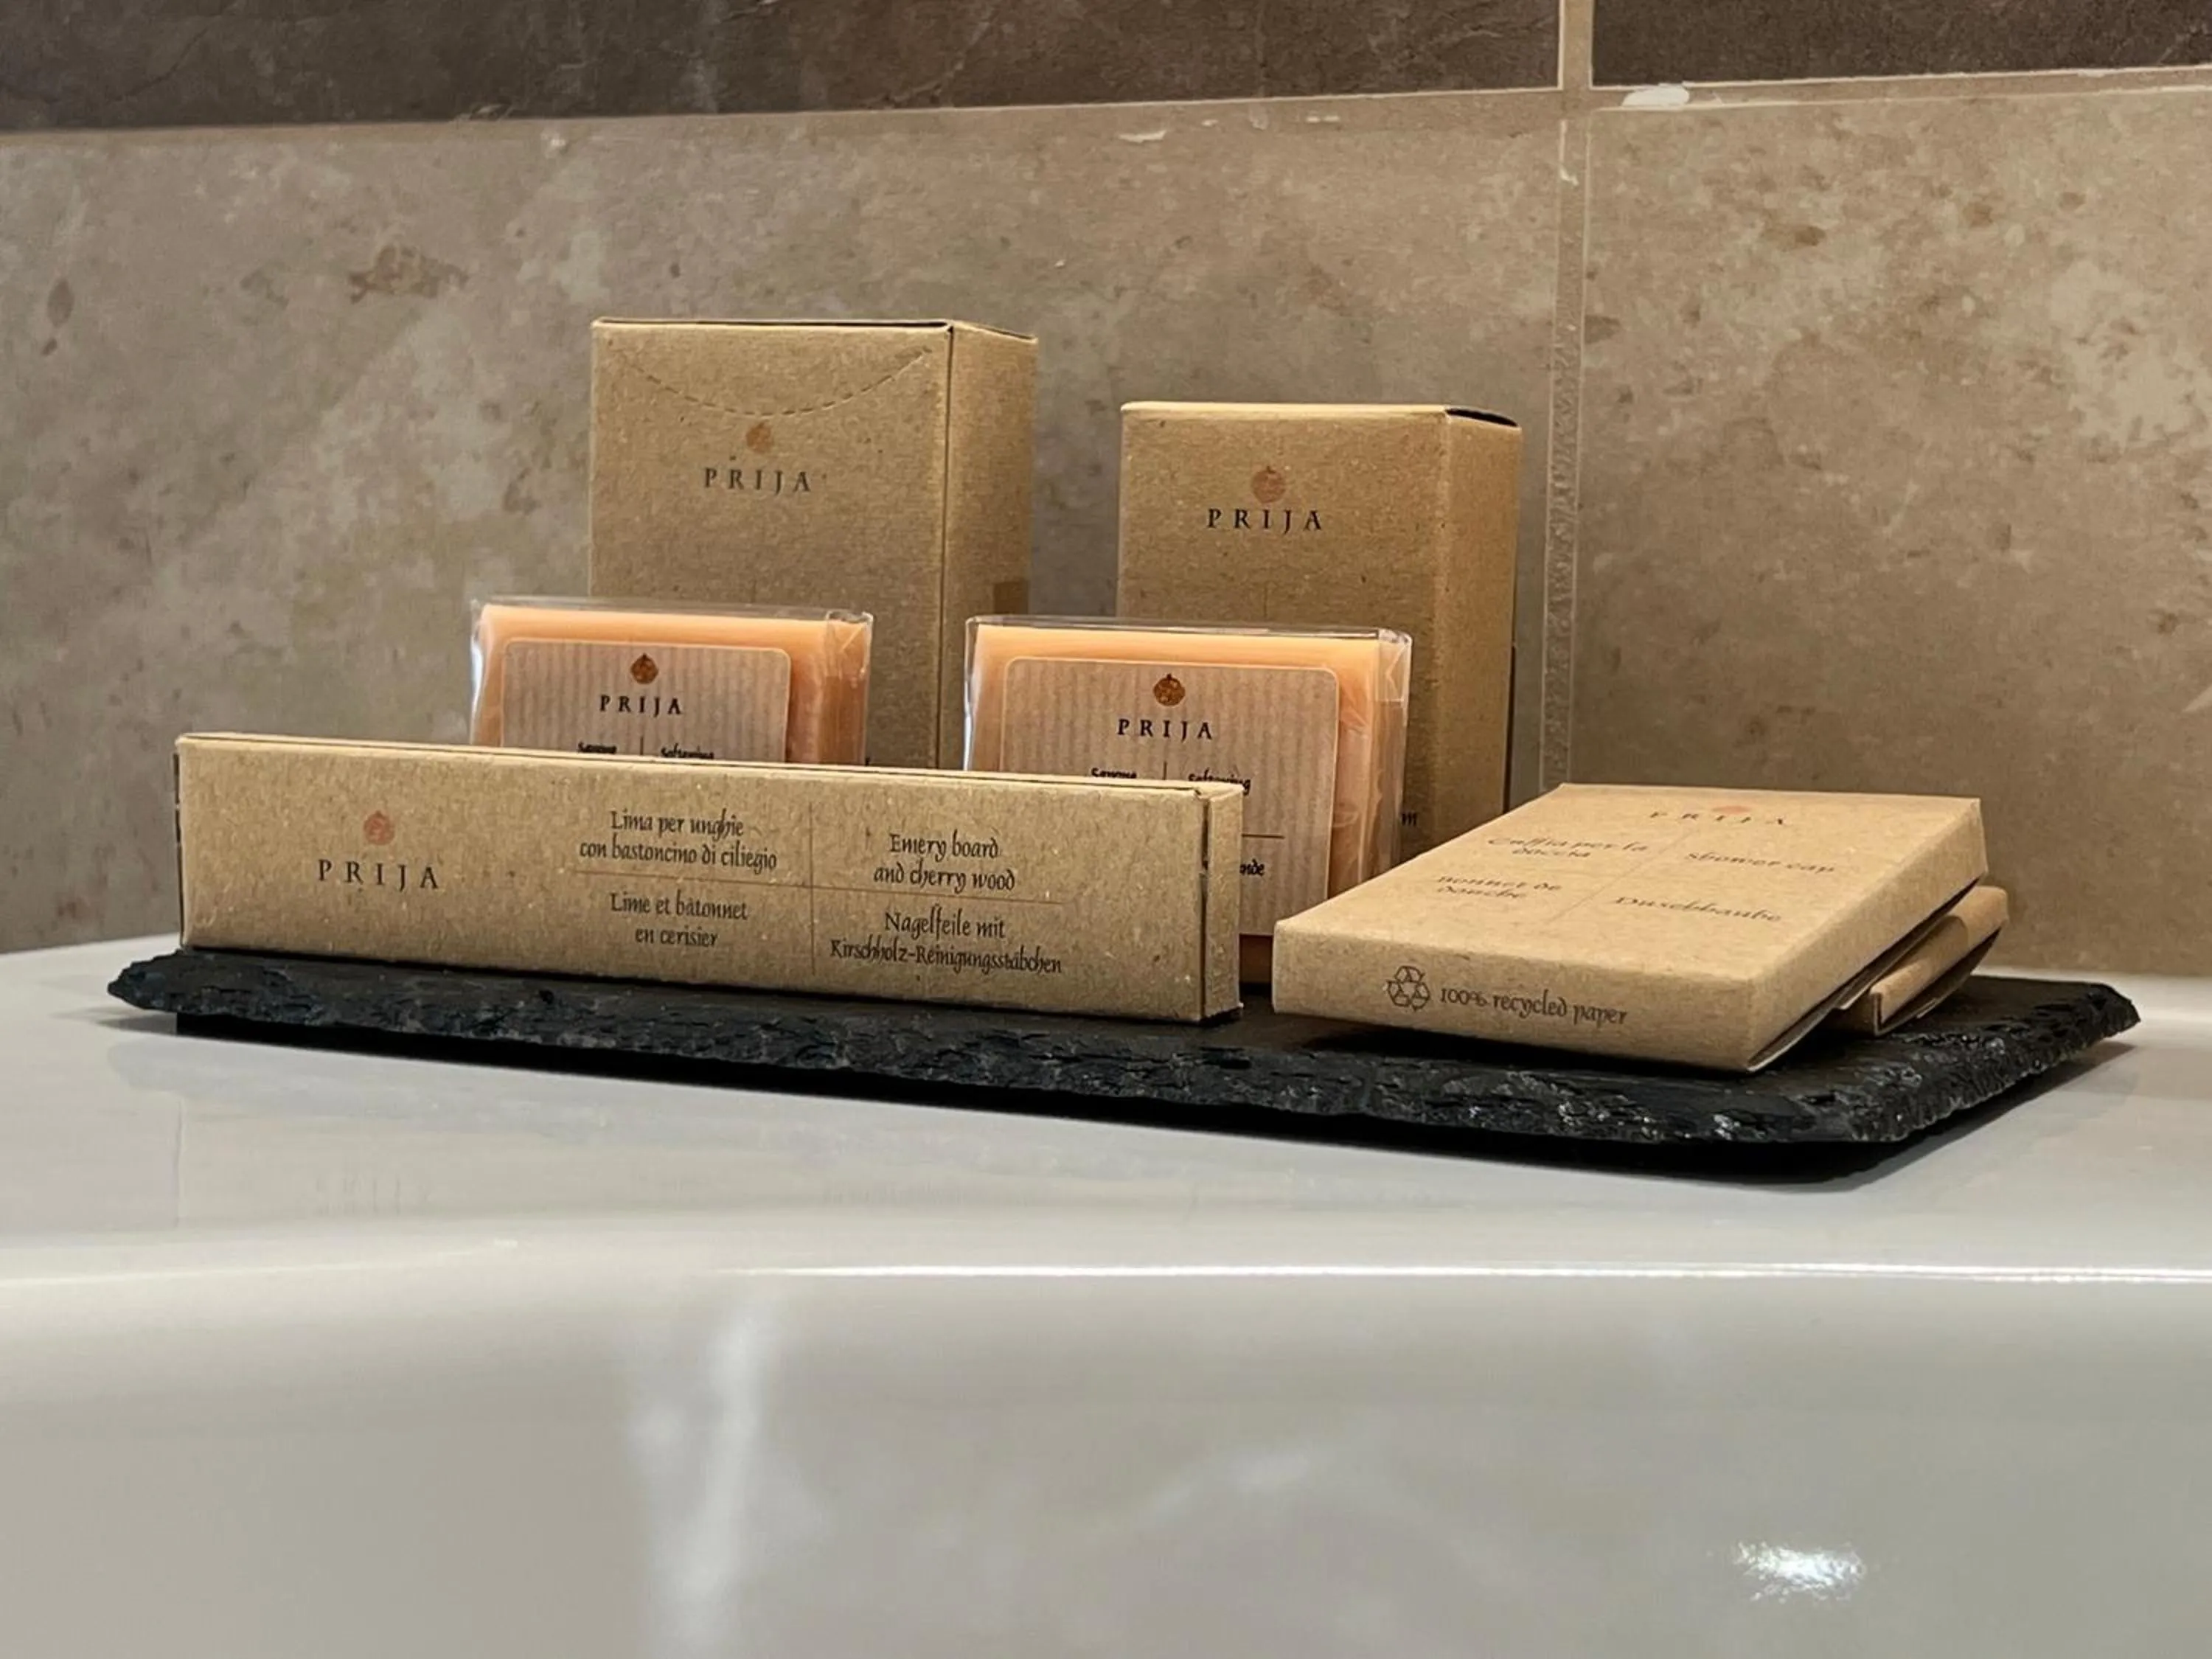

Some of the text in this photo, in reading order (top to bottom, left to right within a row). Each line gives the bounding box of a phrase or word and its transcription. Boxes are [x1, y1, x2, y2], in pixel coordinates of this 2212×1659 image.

[704, 467, 811, 496] PRIJA
[1207, 507, 1323, 535] PRIJA
[599, 695, 682, 717] PRIJA
[1117, 718, 1212, 742] PRIJA
[611, 808, 744, 841] Lima per unghie
[580, 832, 778, 875] con bastoncino di ciliegio
[888, 829, 999, 863] Emery board
[319, 859, 439, 892] PRIJA
[873, 858, 1016, 894] and cherry wood
[610, 890, 651, 913] Lime
[655, 897, 670, 916] et
[635, 924, 719, 947] en cerisier
[885, 903, 1006, 940] Nagelfeile mit
[1440, 987, 1628, 1029] 100% recycled paper
